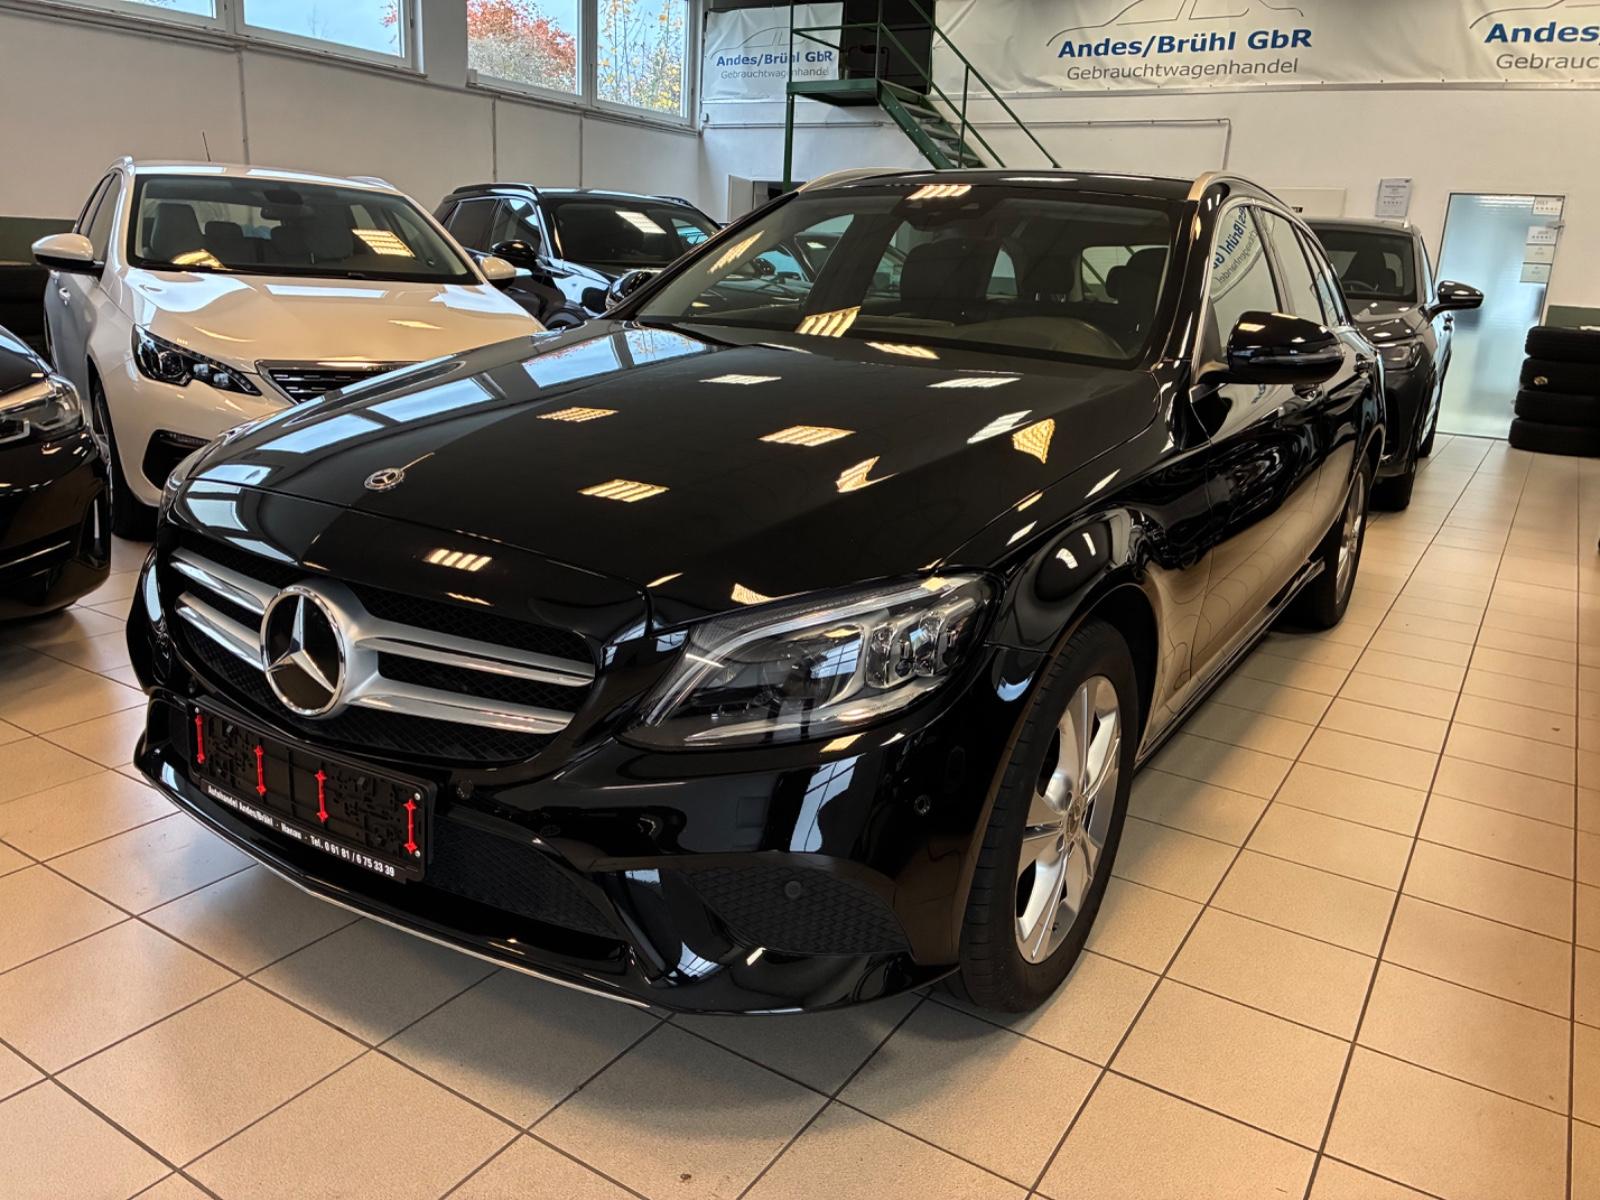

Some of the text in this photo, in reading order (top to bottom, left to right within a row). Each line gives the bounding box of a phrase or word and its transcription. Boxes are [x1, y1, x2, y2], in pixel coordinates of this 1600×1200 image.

[1058, 29, 1312, 58] Andes/Brühl GbR
[805, 50, 833, 63] GbR
[721, 68, 829, 80] Gebrauchtwagnhandel
[1067, 58, 1298, 80] Gebrauchtwagenhandel
[281, 822, 302, 839] Hanau
[310, 835, 323, 849] Tel.
[324, 841, 330, 851] 0
[330, 844, 340, 855] 61
[341, 848, 350, 859] 81
[356, 854, 362, 864] 6
[362, 856, 372, 868] 75
[373, 861, 383, 872] 33
[384, 865, 395, 877] 39
